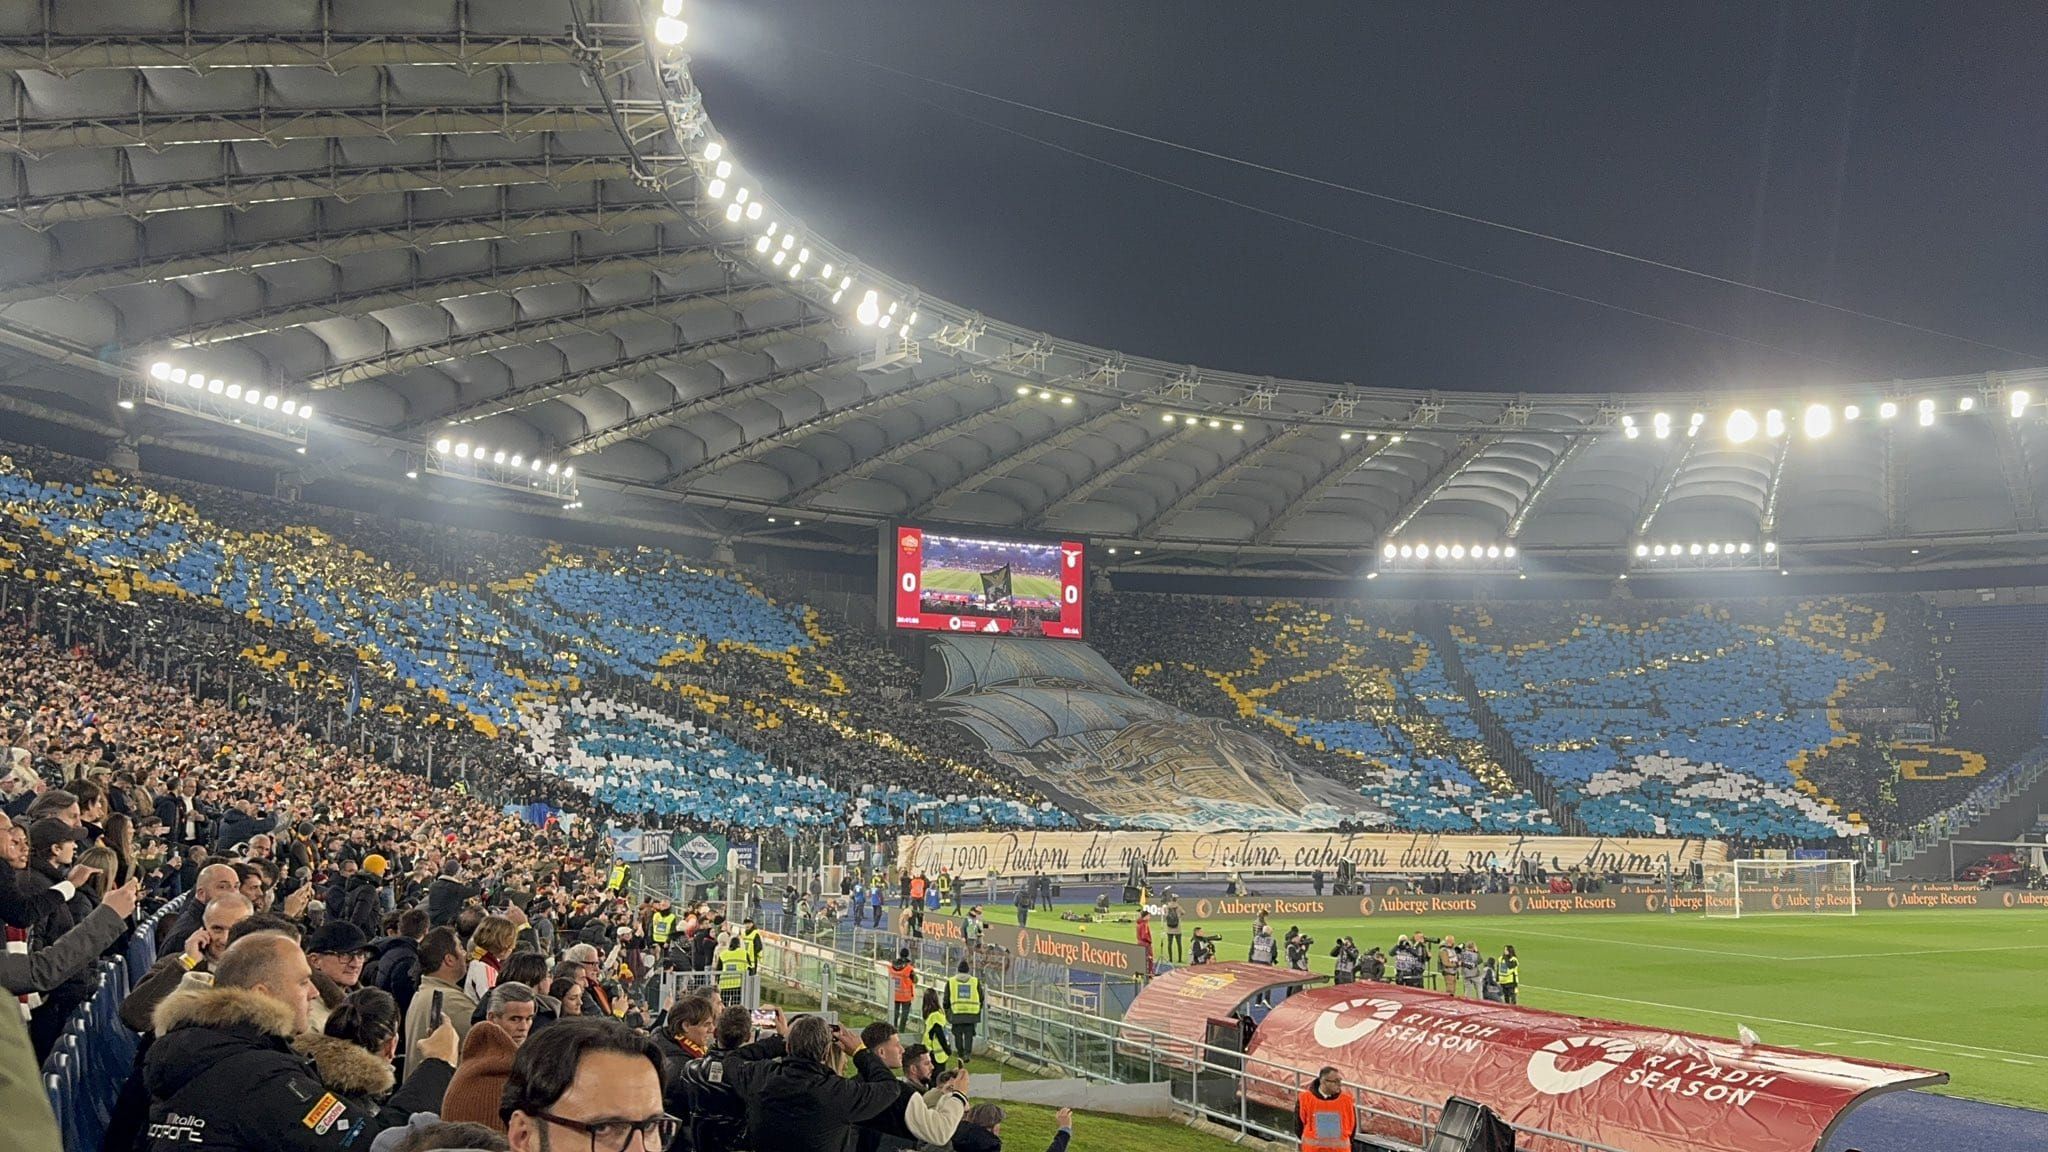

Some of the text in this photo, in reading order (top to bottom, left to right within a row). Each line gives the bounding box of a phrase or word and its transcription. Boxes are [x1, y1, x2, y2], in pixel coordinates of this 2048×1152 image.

[902, 572, 916, 593] 0
[1065, 584, 1078, 604] 0
[950, 846, 988, 877] 1900
[993, 831, 1072, 875] Padroni
[1400, 832, 1452, 869] della
[1216, 899, 1325, 917] Auberge Resorts
[1379, 897, 1477, 915] Auberge Resorts
[1527, 895, 1616, 912] Auberge Resorts
[1901, 892, 1977, 907] Auberge Resorts
[1032, 933, 1079, 965] Auberge
[1080, 941, 1129, 970] Resorts
[1403, 1013, 1500, 1037] RIYADH
[1385, 1024, 1481, 1053] SEASON
[1643, 1055, 1777, 1088] RIYADH
[1623, 1069, 1757, 1107] SEASON
